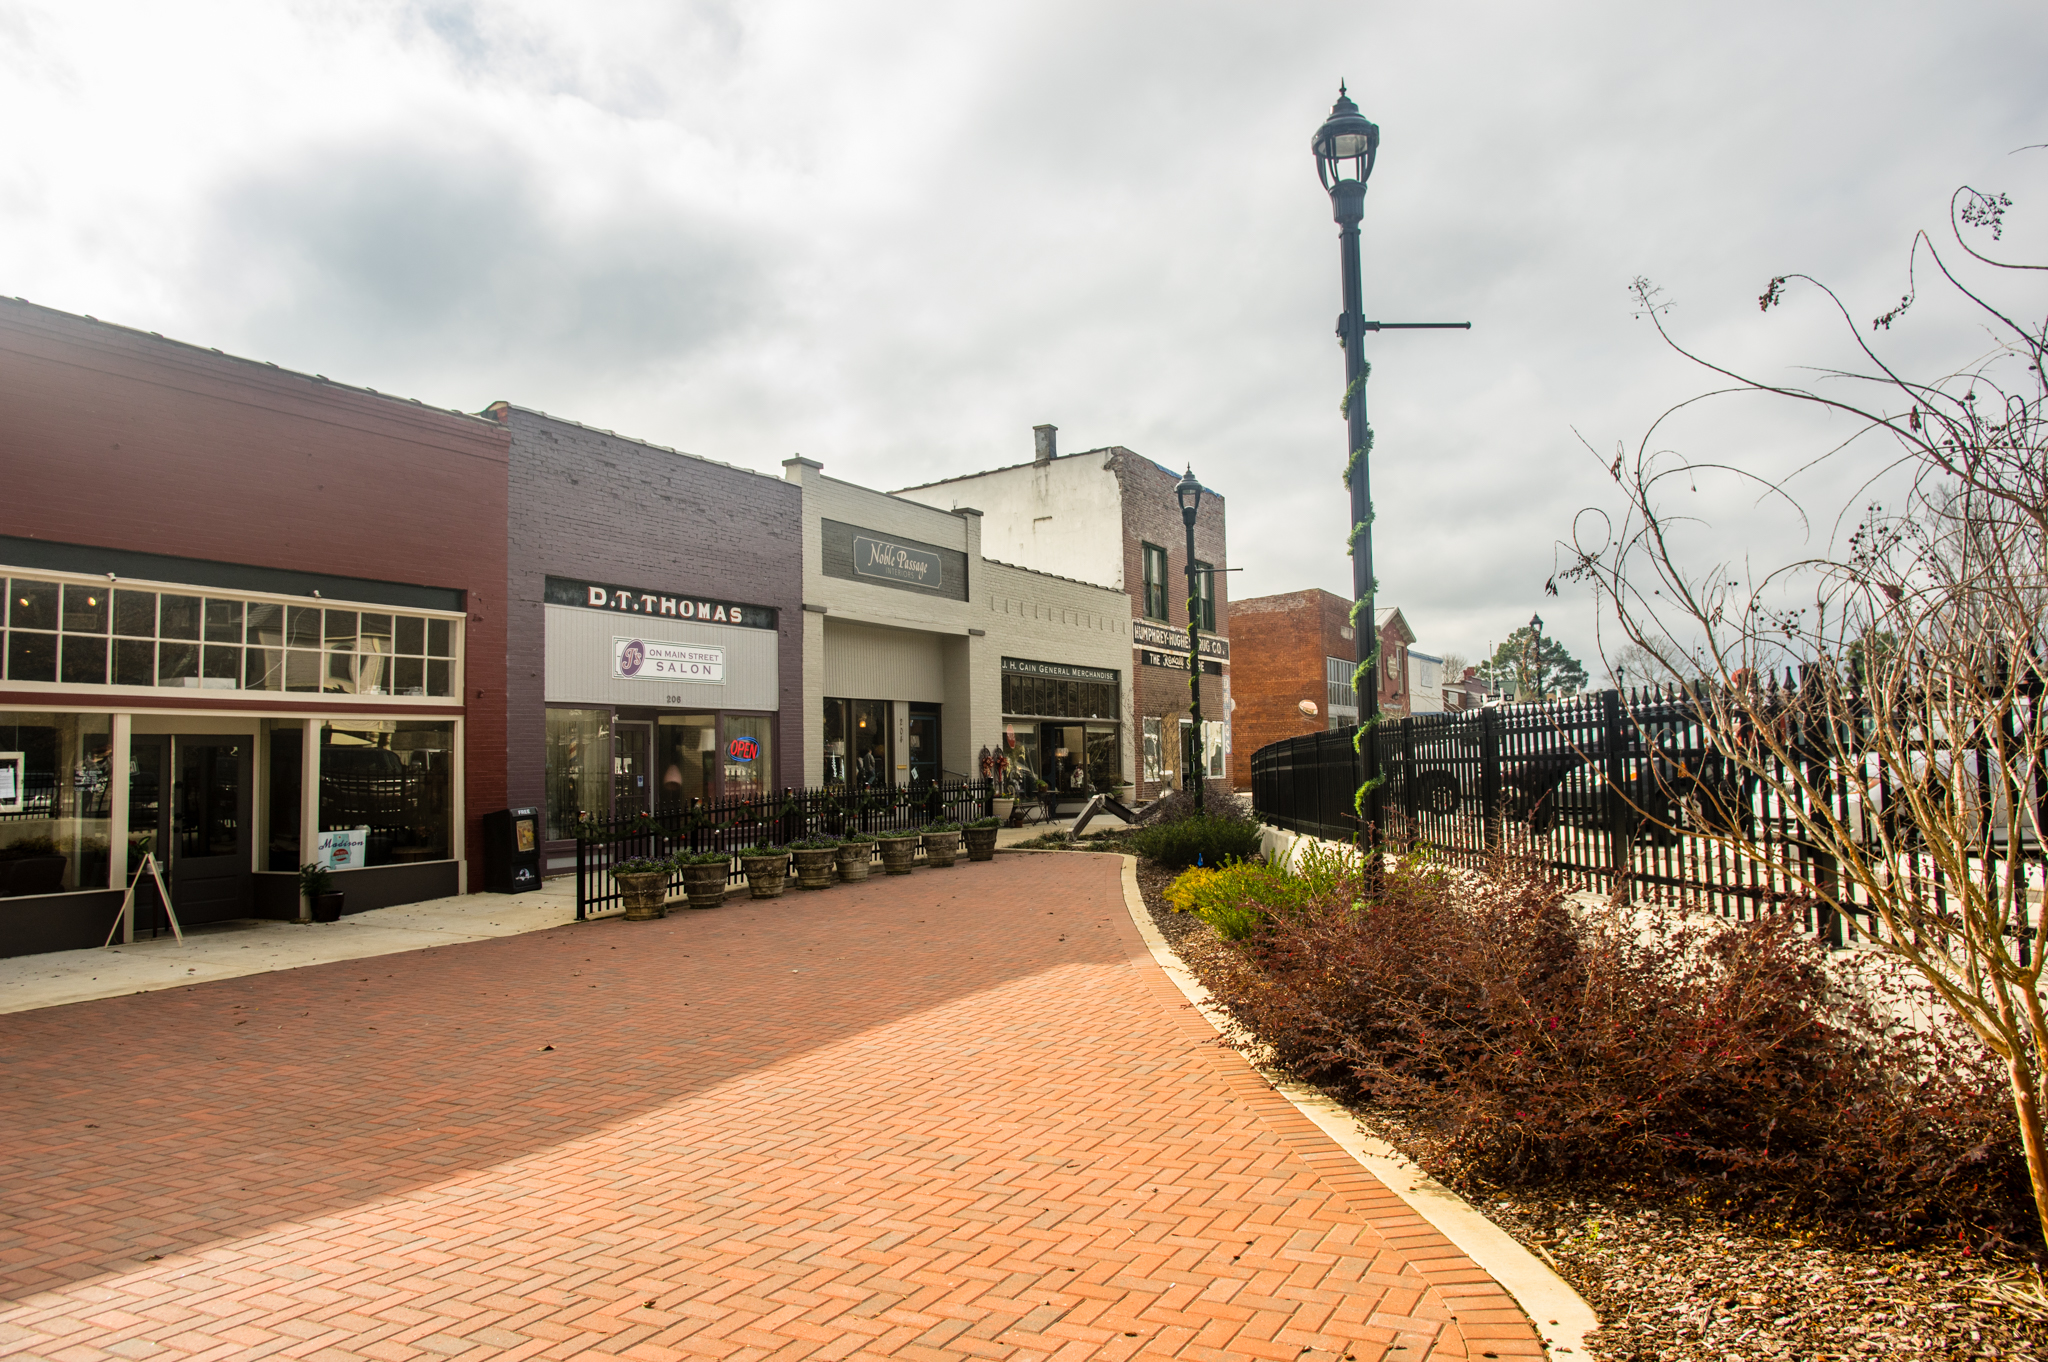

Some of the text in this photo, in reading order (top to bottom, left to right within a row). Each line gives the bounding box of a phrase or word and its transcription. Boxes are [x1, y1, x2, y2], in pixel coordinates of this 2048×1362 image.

[867, 543, 928, 580] Noble Passage
[885, 567, 915, 579] INTERIORS
[1198, 638, 1210, 653] RUG
[1211, 641, 1225, 655] CO.
[649, 649, 719, 662] ON MAIN STREET
[1149, 653, 1161, 666] THE
[1186, 658, 1205, 672] SRE
[656, 661, 712, 675] SALON
[1001, 660, 1008, 669] J.
[1009, 660, 1017, 670] H.
[1039, 665, 1070, 676] GENERAL
[1072, 668, 1114, 680] MERCHANDISE
[666, 694, 682, 704] 206
[1223, 677, 1231, 754] DRUGS
[730, 739, 757, 760] OPEN
[318, 838, 364, 850] Madison
